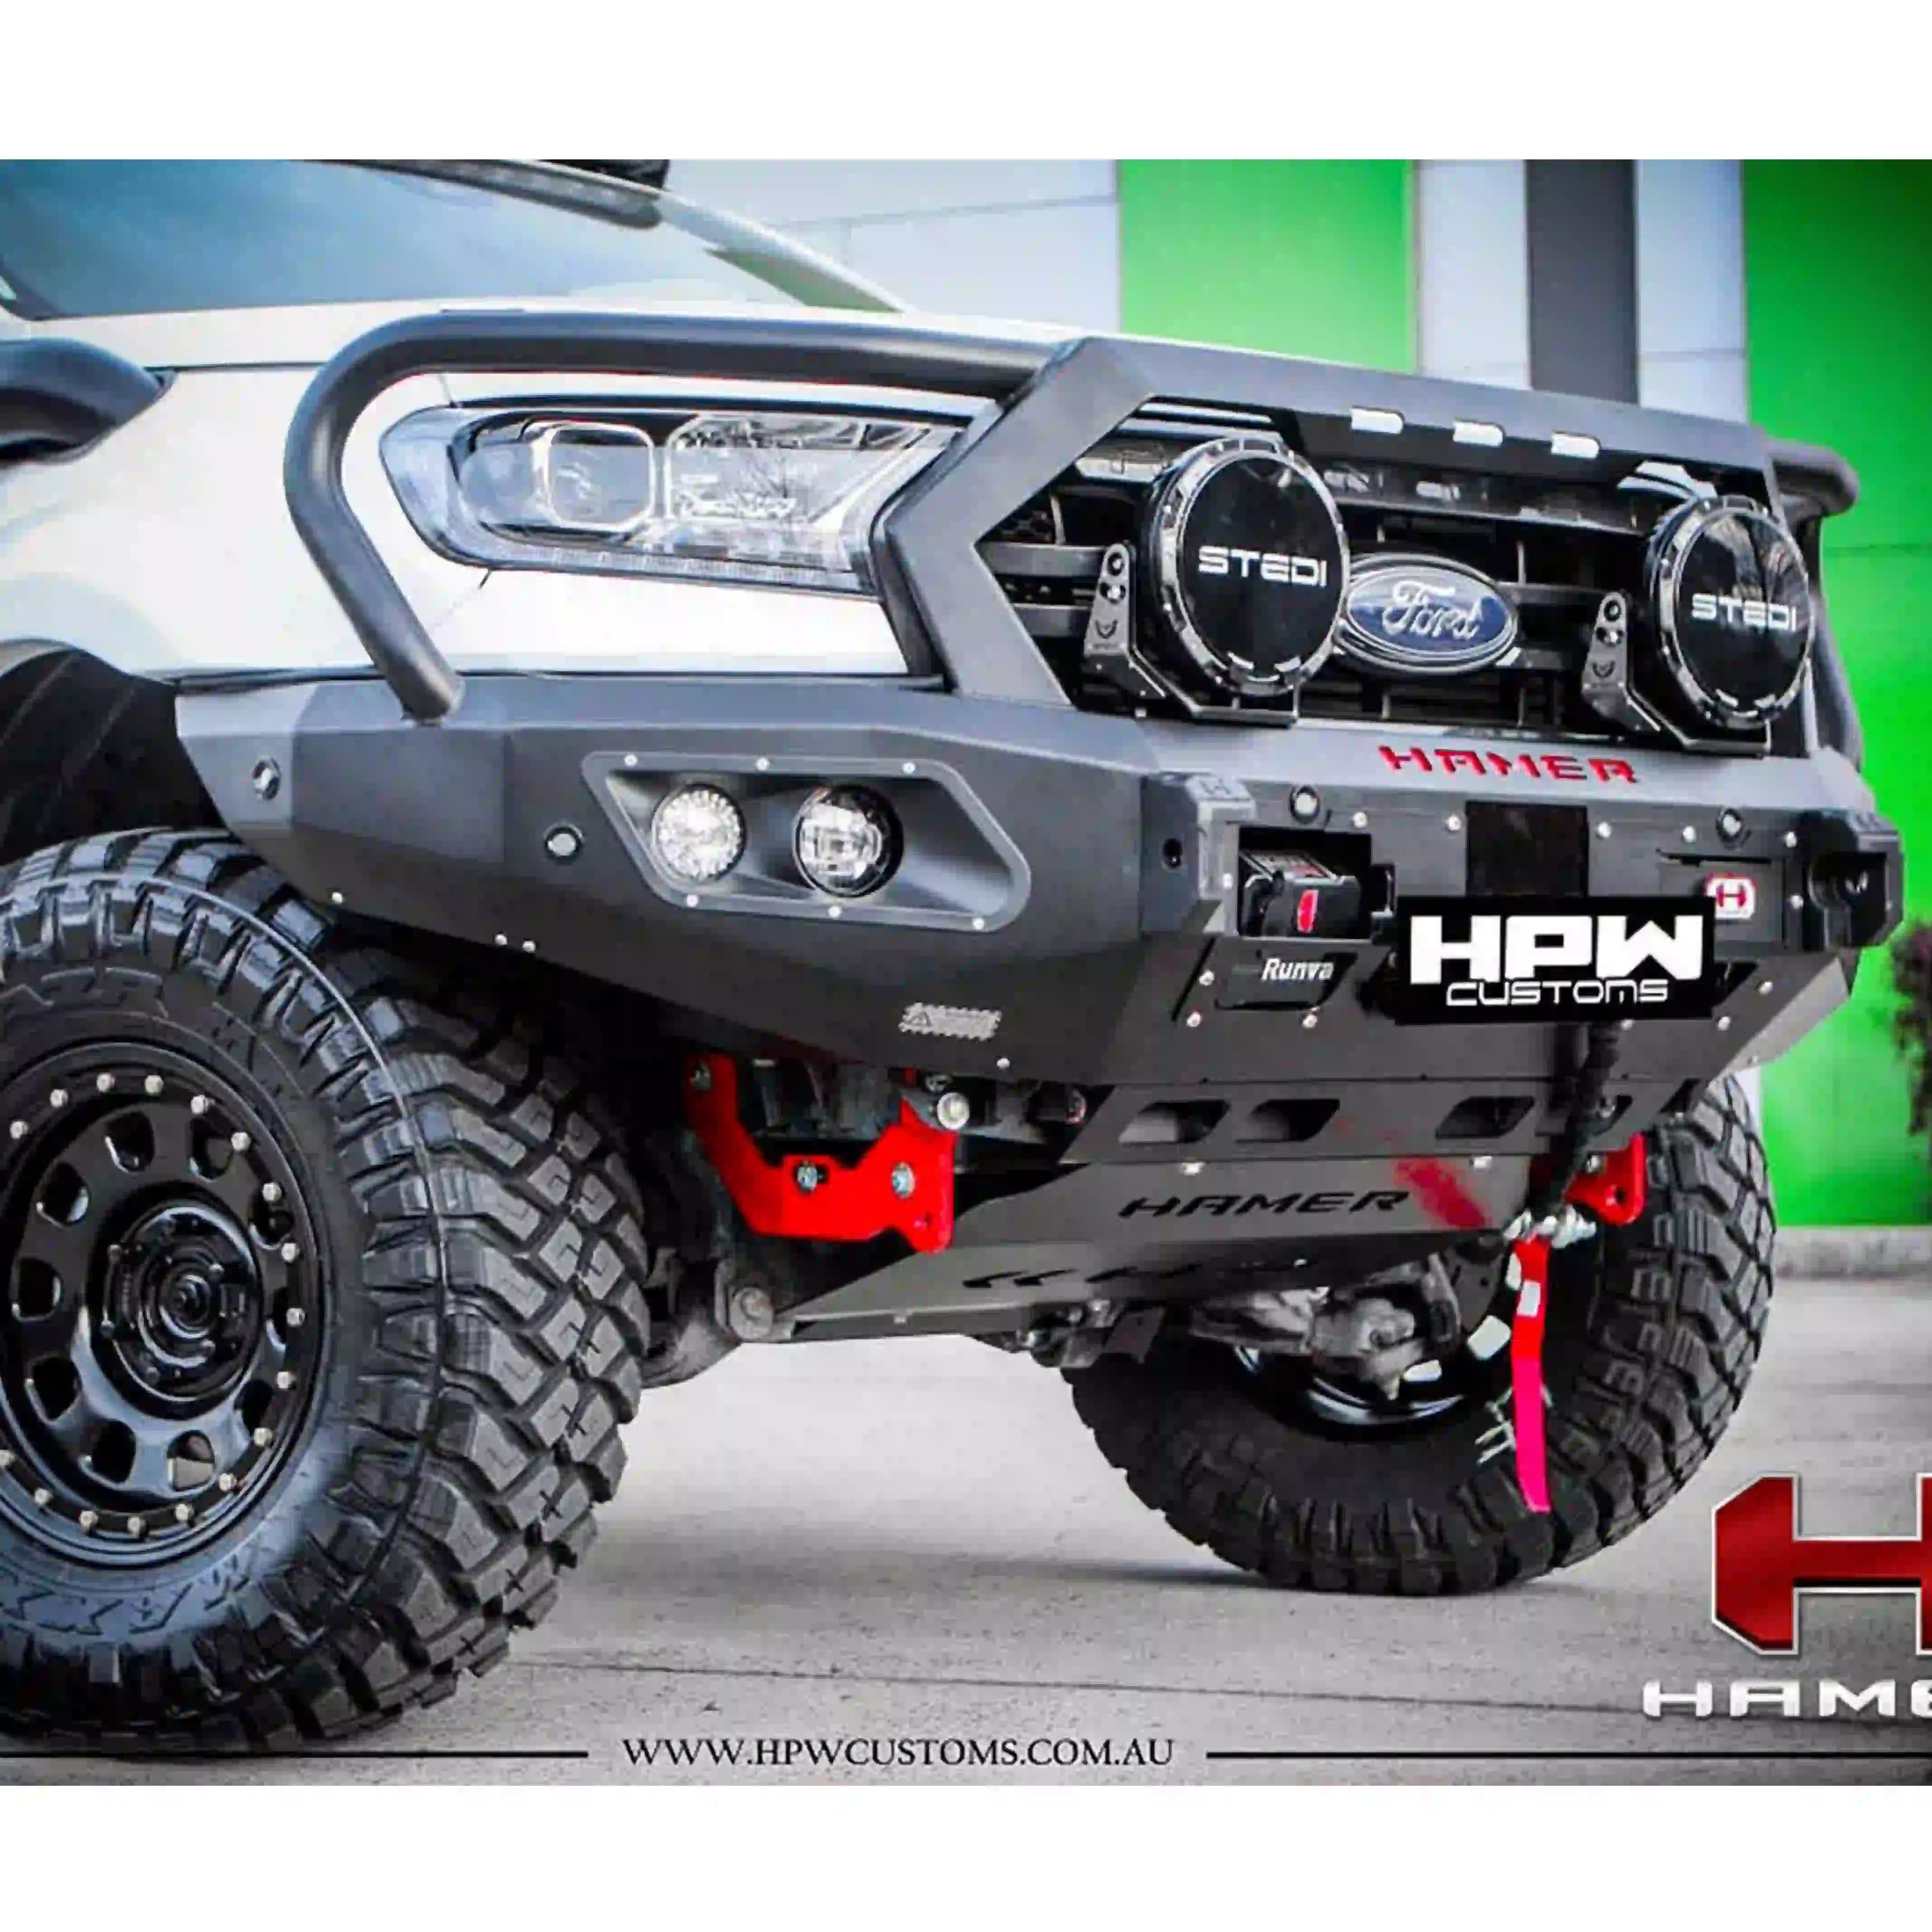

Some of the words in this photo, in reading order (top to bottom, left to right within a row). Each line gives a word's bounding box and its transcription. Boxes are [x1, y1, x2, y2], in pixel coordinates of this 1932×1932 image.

[1198, 545, 1327, 588] STEDI
[1382, 580, 1484, 639] Ford
[1692, 593, 1797, 633] STEDI
[1379, 745, 1638, 783] HAMER
[1261, 957, 1334, 982] Runva
[1117, 1191, 1410, 1218] HAMER
